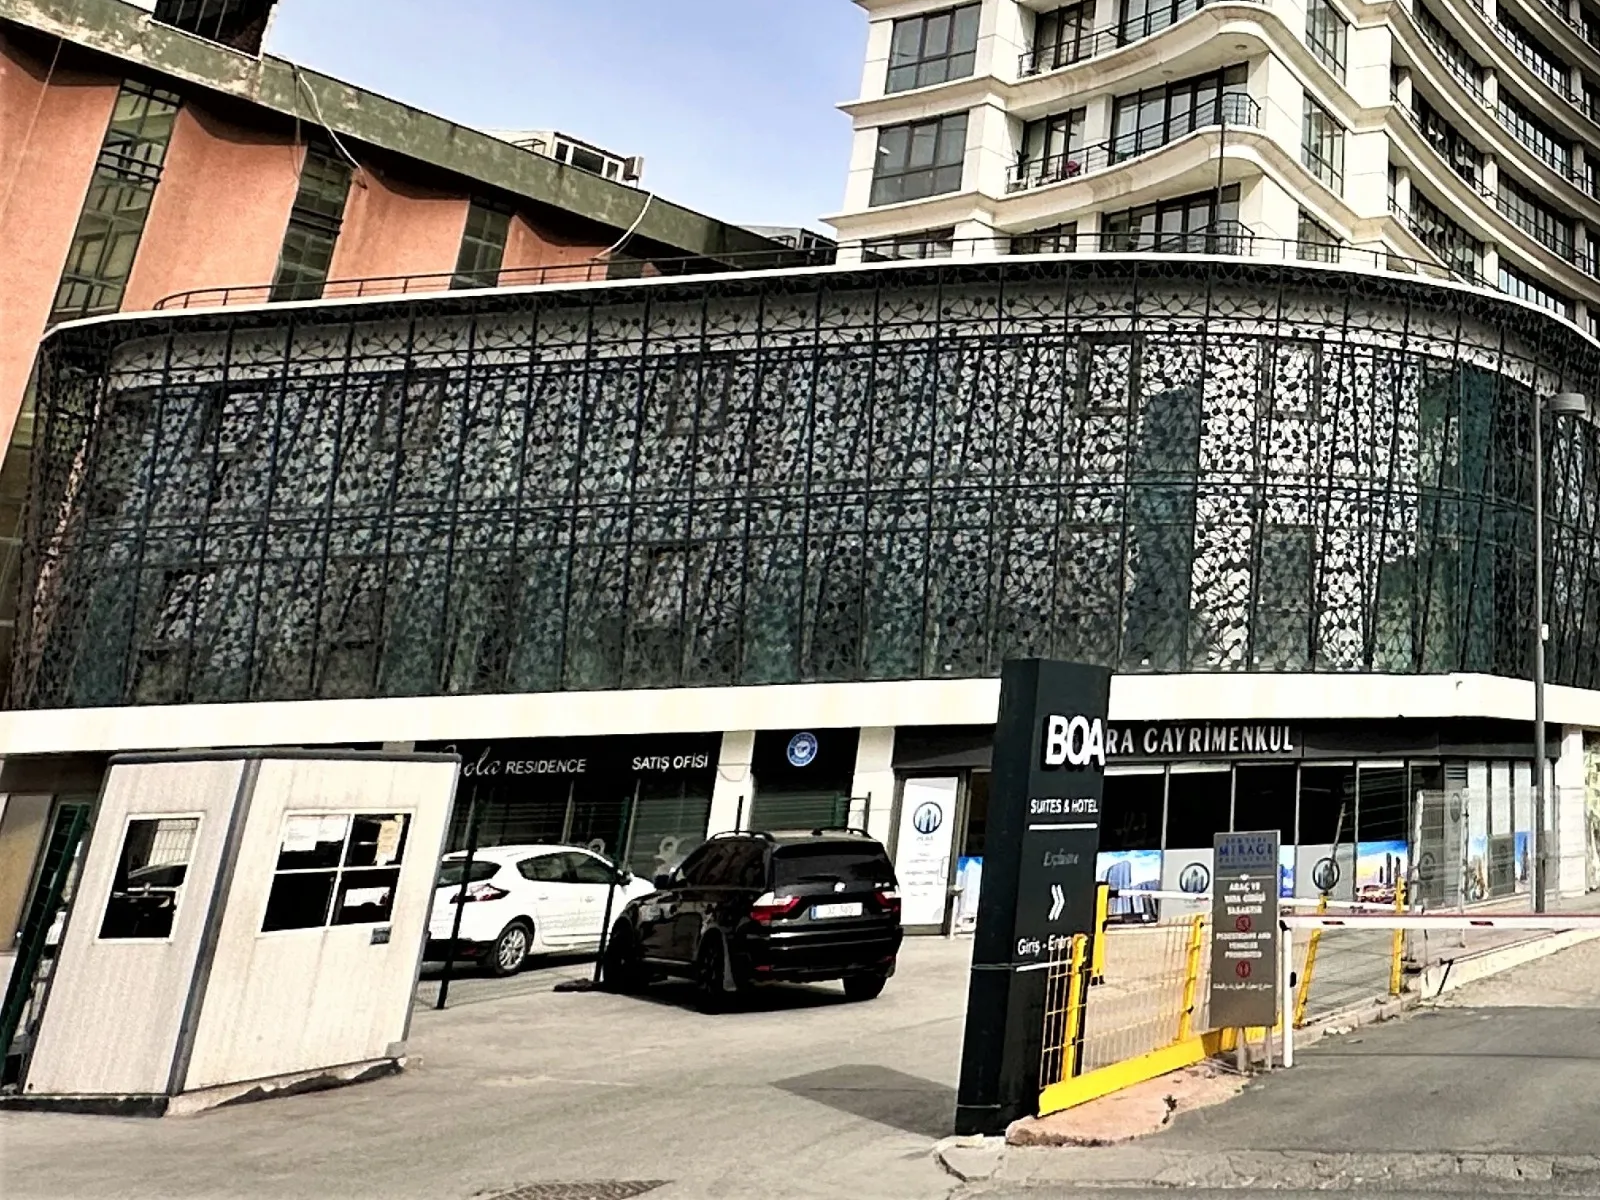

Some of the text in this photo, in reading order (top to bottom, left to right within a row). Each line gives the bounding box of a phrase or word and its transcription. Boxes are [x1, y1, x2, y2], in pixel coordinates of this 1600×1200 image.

[1045, 715, 1106, 765] BOA
[1105, 721, 1294, 754] RA GAYRİMENKUL
[504, 758, 587, 775] RESIDENCE
[631, 751, 709, 773] SATIŞ OFİSİ
[1030, 799, 1062, 814] SUITES
[1071, 799, 1099, 813] HOTEL
[1219, 843, 1273, 857] MIRAGE
[1017, 937, 1040, 957] Giriş
